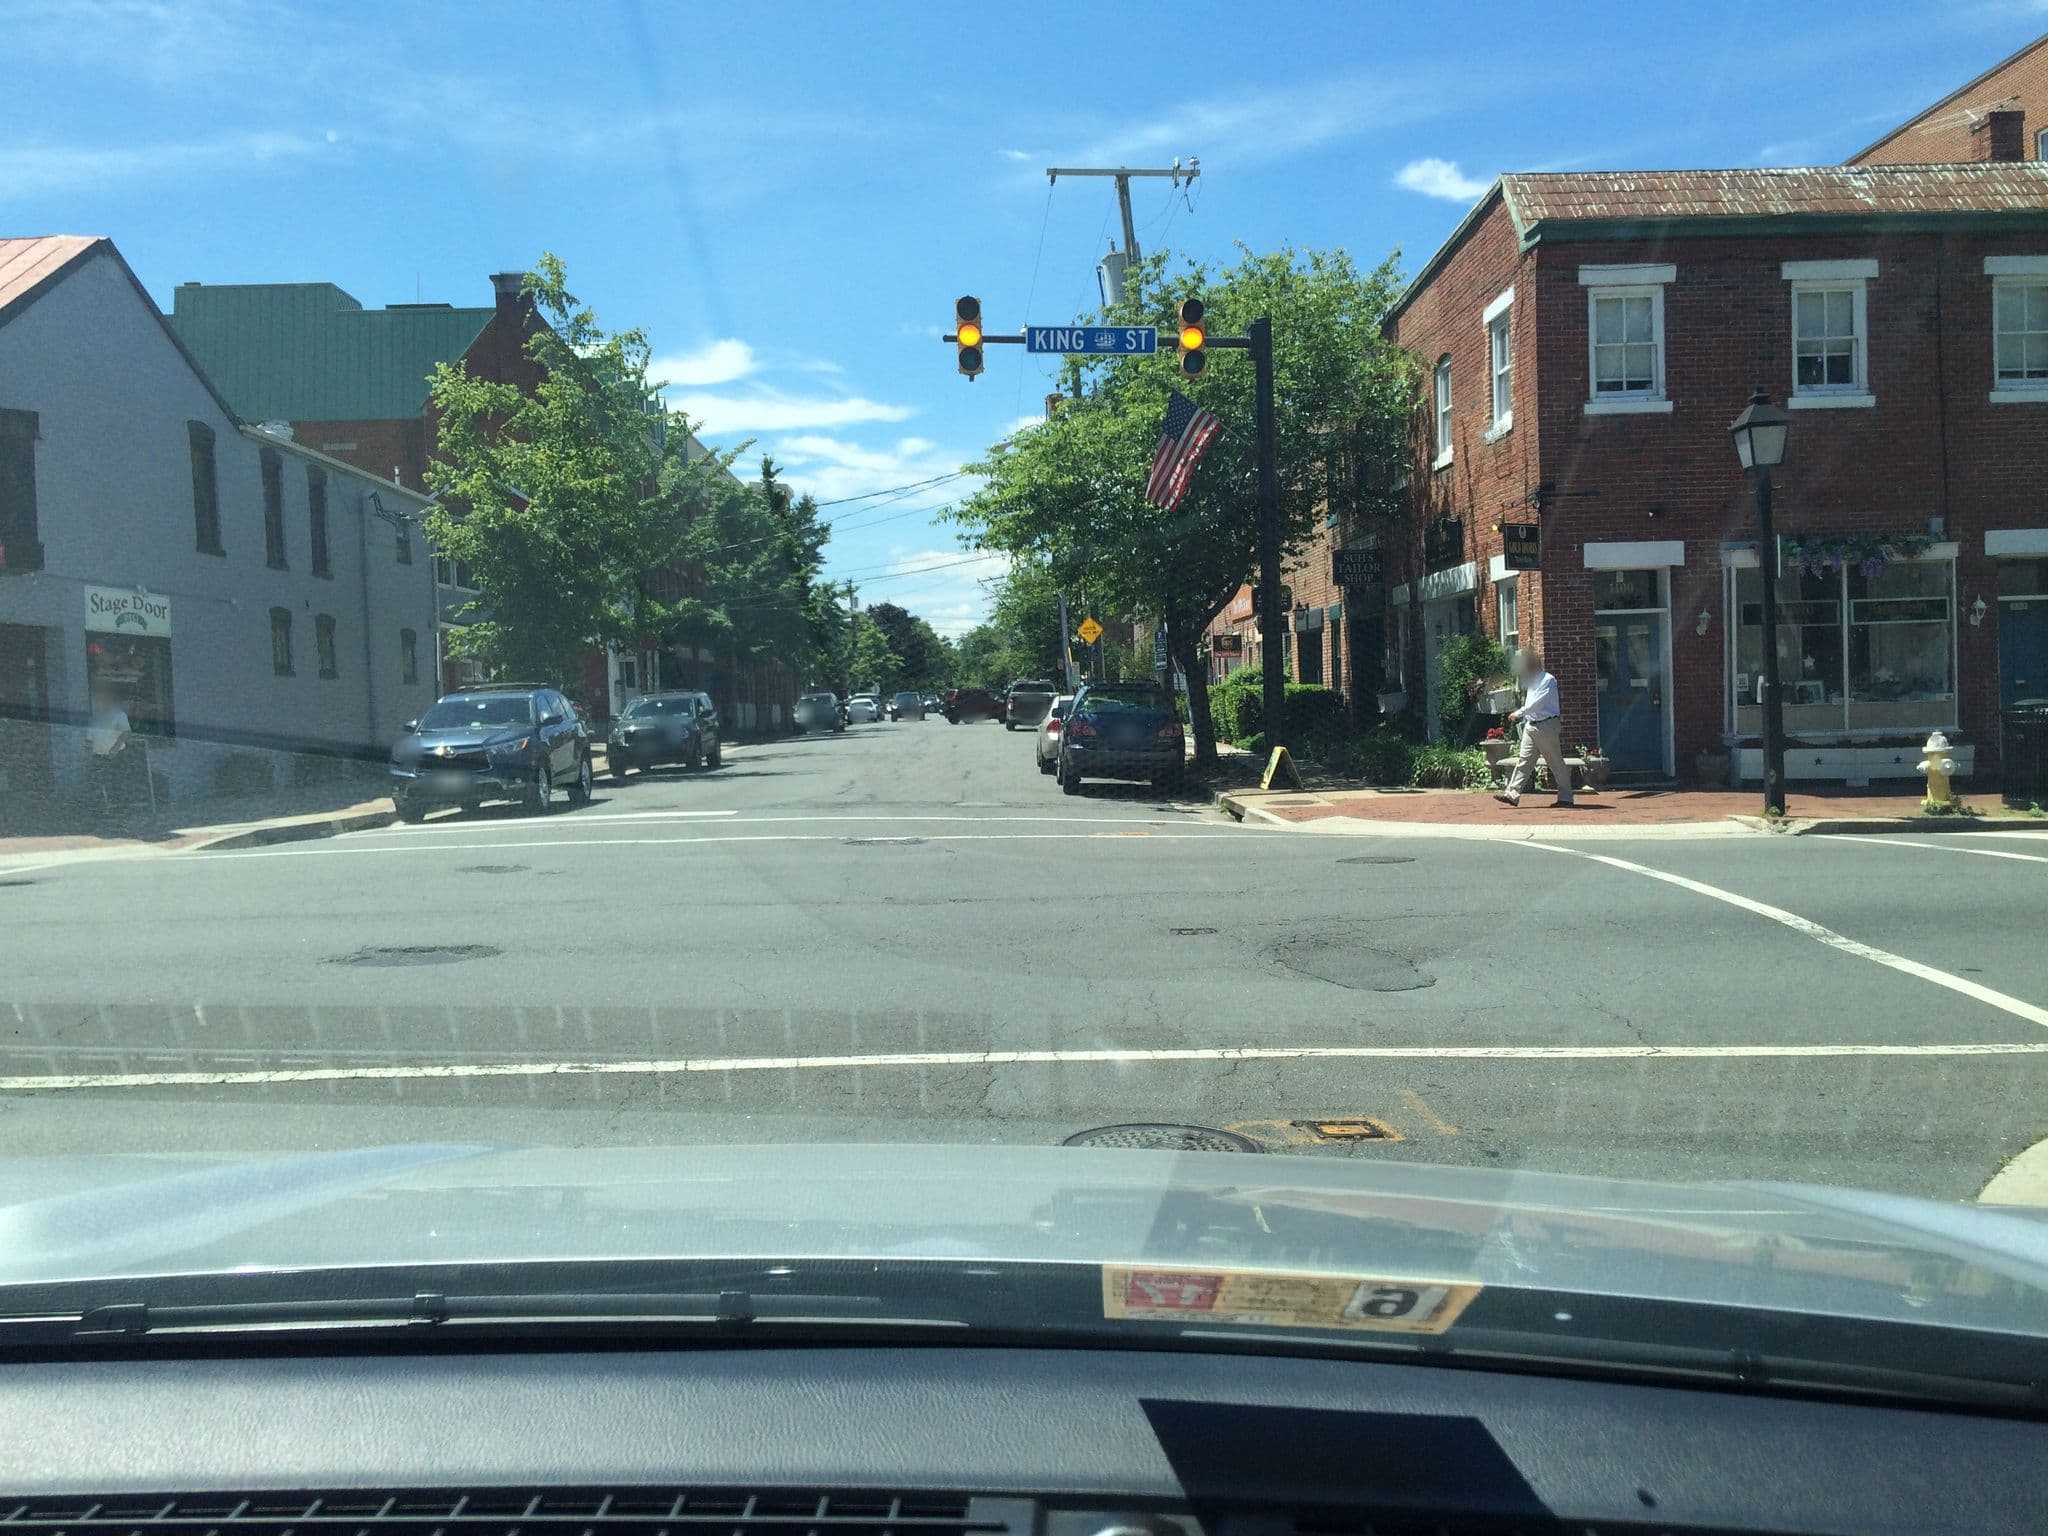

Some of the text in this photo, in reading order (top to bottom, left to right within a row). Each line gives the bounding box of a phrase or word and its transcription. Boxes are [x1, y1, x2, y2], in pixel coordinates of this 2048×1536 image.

[1035, 329, 1148, 350] KING ST
[1338, 562, 1381, 573] TAILOR
[1344, 573, 1374, 583] SHOP
[91, 593, 167, 619] Stage Door
